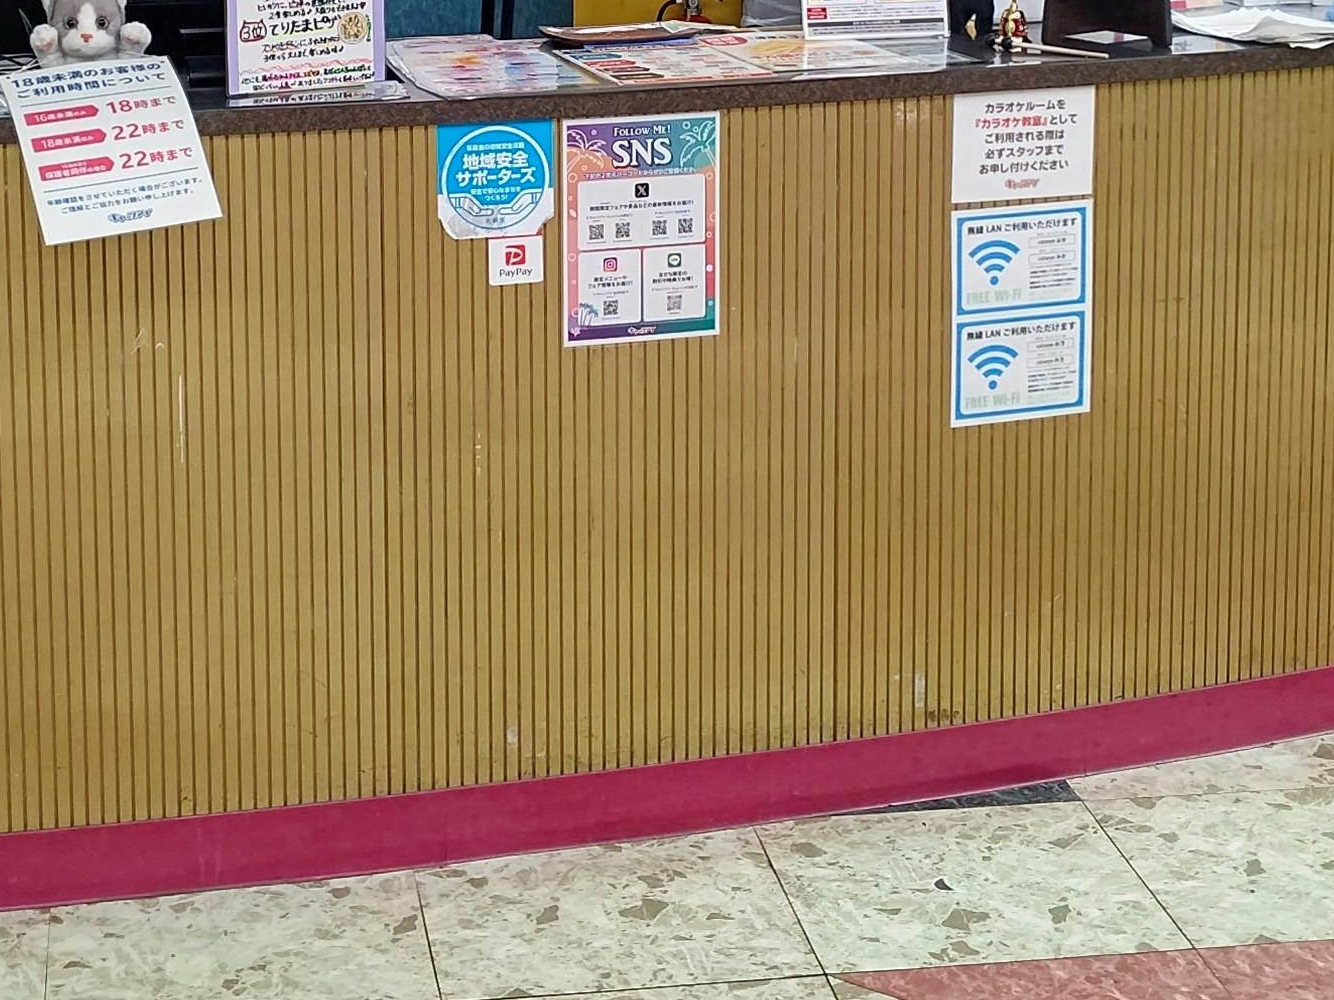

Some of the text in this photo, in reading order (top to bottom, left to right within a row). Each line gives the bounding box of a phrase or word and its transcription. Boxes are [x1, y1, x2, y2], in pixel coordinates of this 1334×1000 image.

[244, 25, 262, 40] 3位
[11, 63, 161, 88] 18歳未満のお客様の
[17, 73, 166, 98] ご利用時間について
[106, 95, 177, 114] 18時まで
[984, 99, 1066, 114] カラオケルームを
[111, 119, 185, 141] 22時まで
[975, 113, 1077, 129] 『カラオケ教室』として
[984, 129, 1065, 143] ご利用される際は
[119, 147, 193, 169] 22時まで
[463, 151, 529, 169] 地域安全
[612, 138, 672, 169] SNS
[984, 145, 1064, 159] 必ずスタッフまで
[979, 160, 1069, 175] お申し付けください
[455, 168, 536, 187] サポーターズ
[47, 177, 203, 206] 年齢確認をさせていただく場合がございます。
[61, 188, 195, 214] ご理解とご協力をお願い申し上げます。
[967, 217, 1078, 236] 無線 LAN ご利用いただけます
[499, 267, 533, 277] PayPay
[966, 321, 1077, 341] 無線 LAN ご利用いただけます
